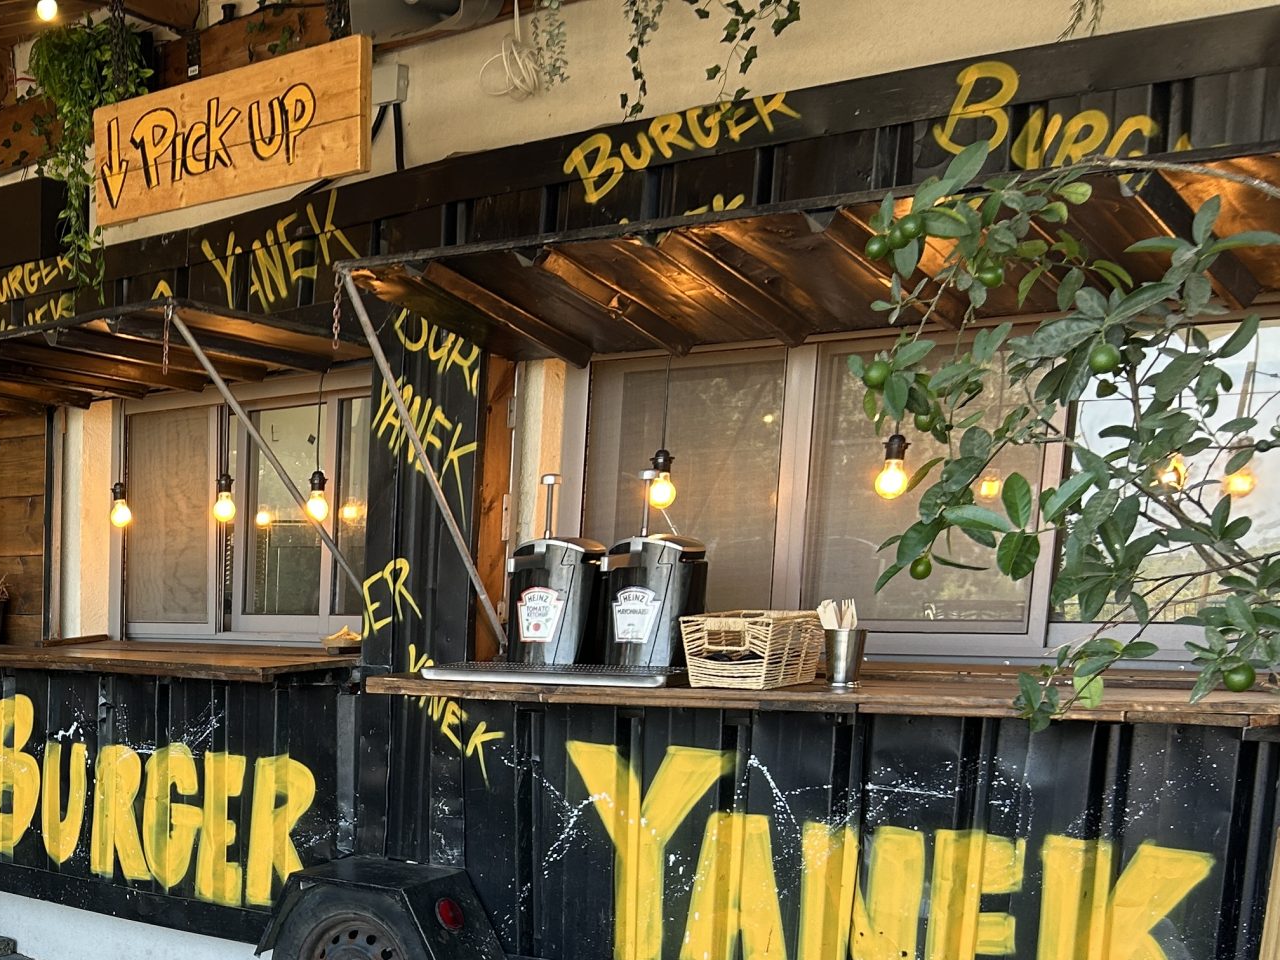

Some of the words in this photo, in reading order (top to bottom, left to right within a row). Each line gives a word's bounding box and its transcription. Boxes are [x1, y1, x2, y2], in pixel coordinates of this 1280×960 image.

[249, 82, 316, 165] UP
[563, 92, 801, 204] BURGER
[527, 593, 549, 603] HEINZ
[622, 593, 646, 603] HEINZ
